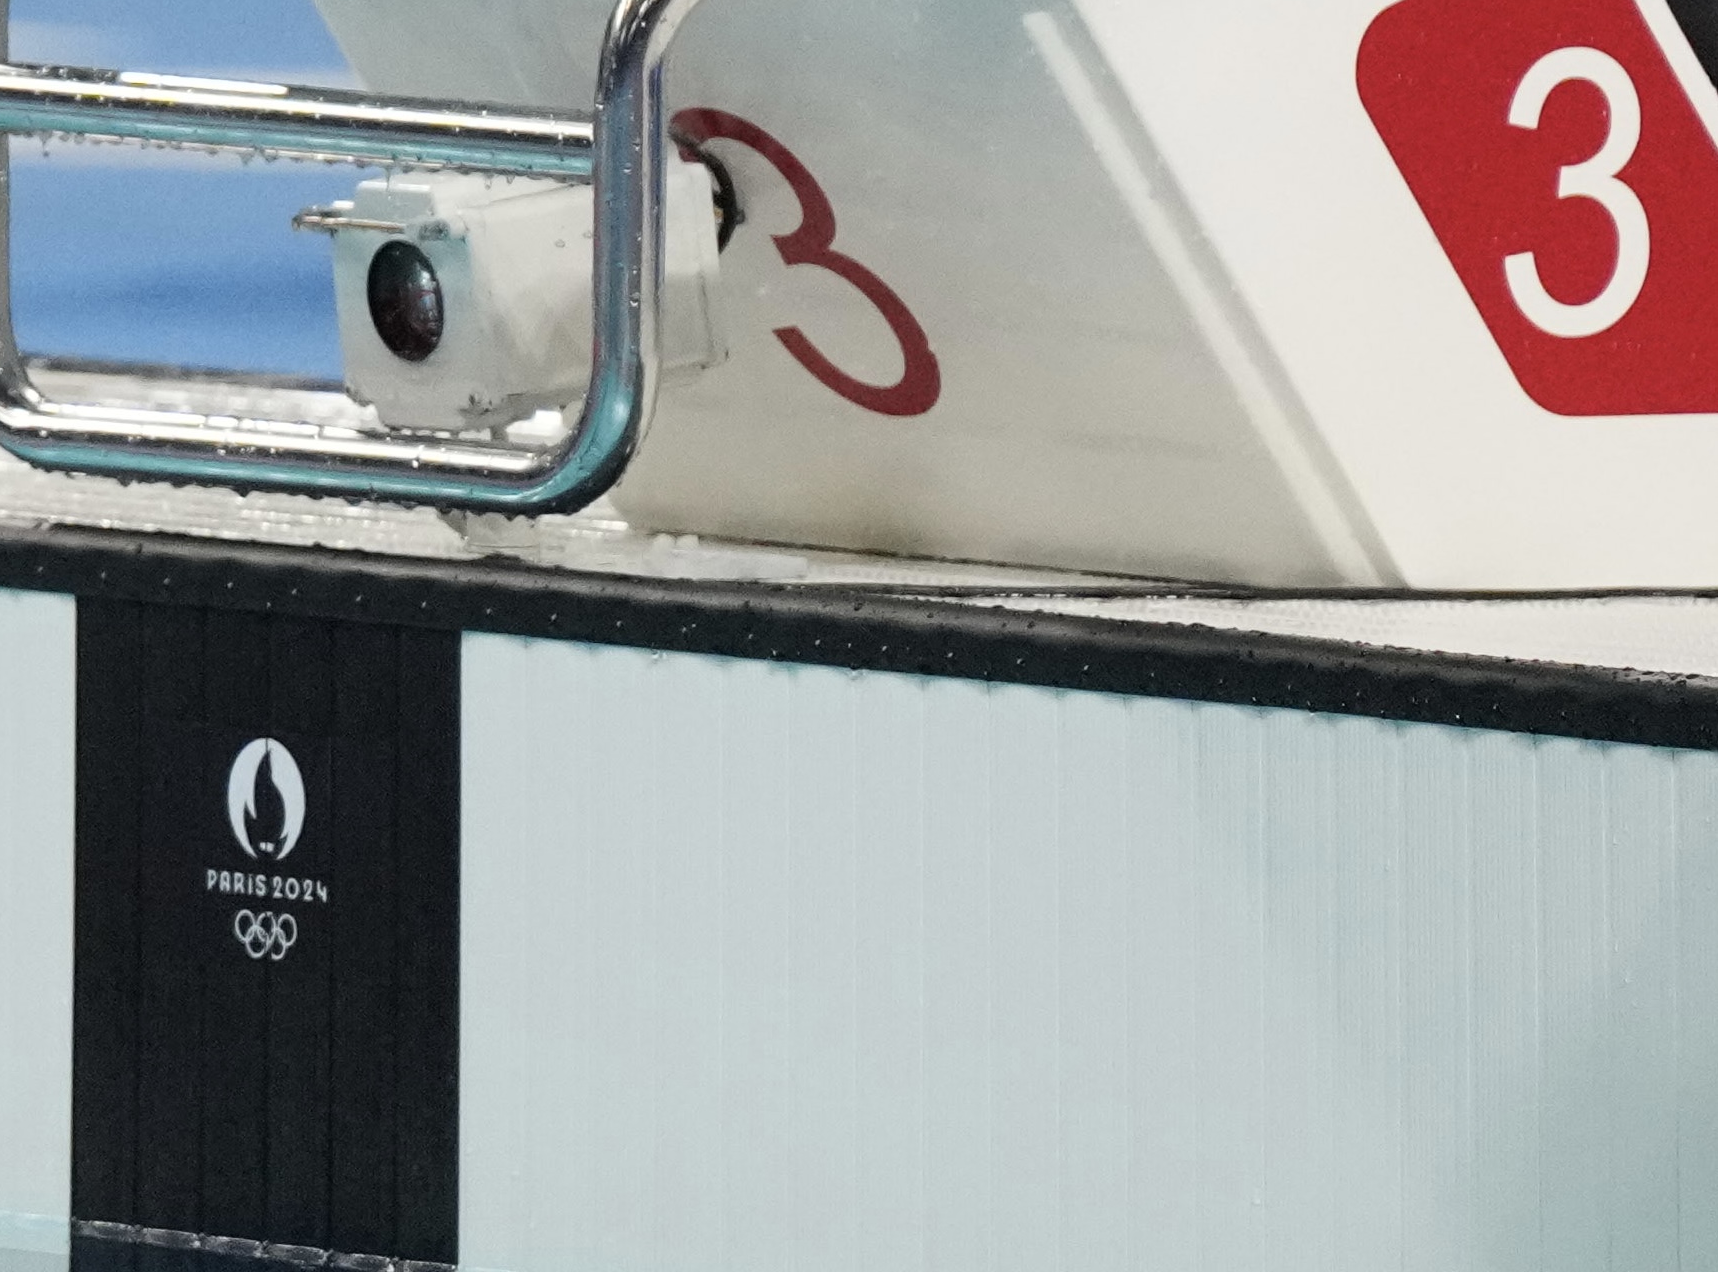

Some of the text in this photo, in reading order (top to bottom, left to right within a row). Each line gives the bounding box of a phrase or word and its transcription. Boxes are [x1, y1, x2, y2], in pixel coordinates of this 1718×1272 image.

[670, 105, 943, 417] 3
[1503, 45, 1652, 339] 3
[272, 875, 328, 903] 2024
